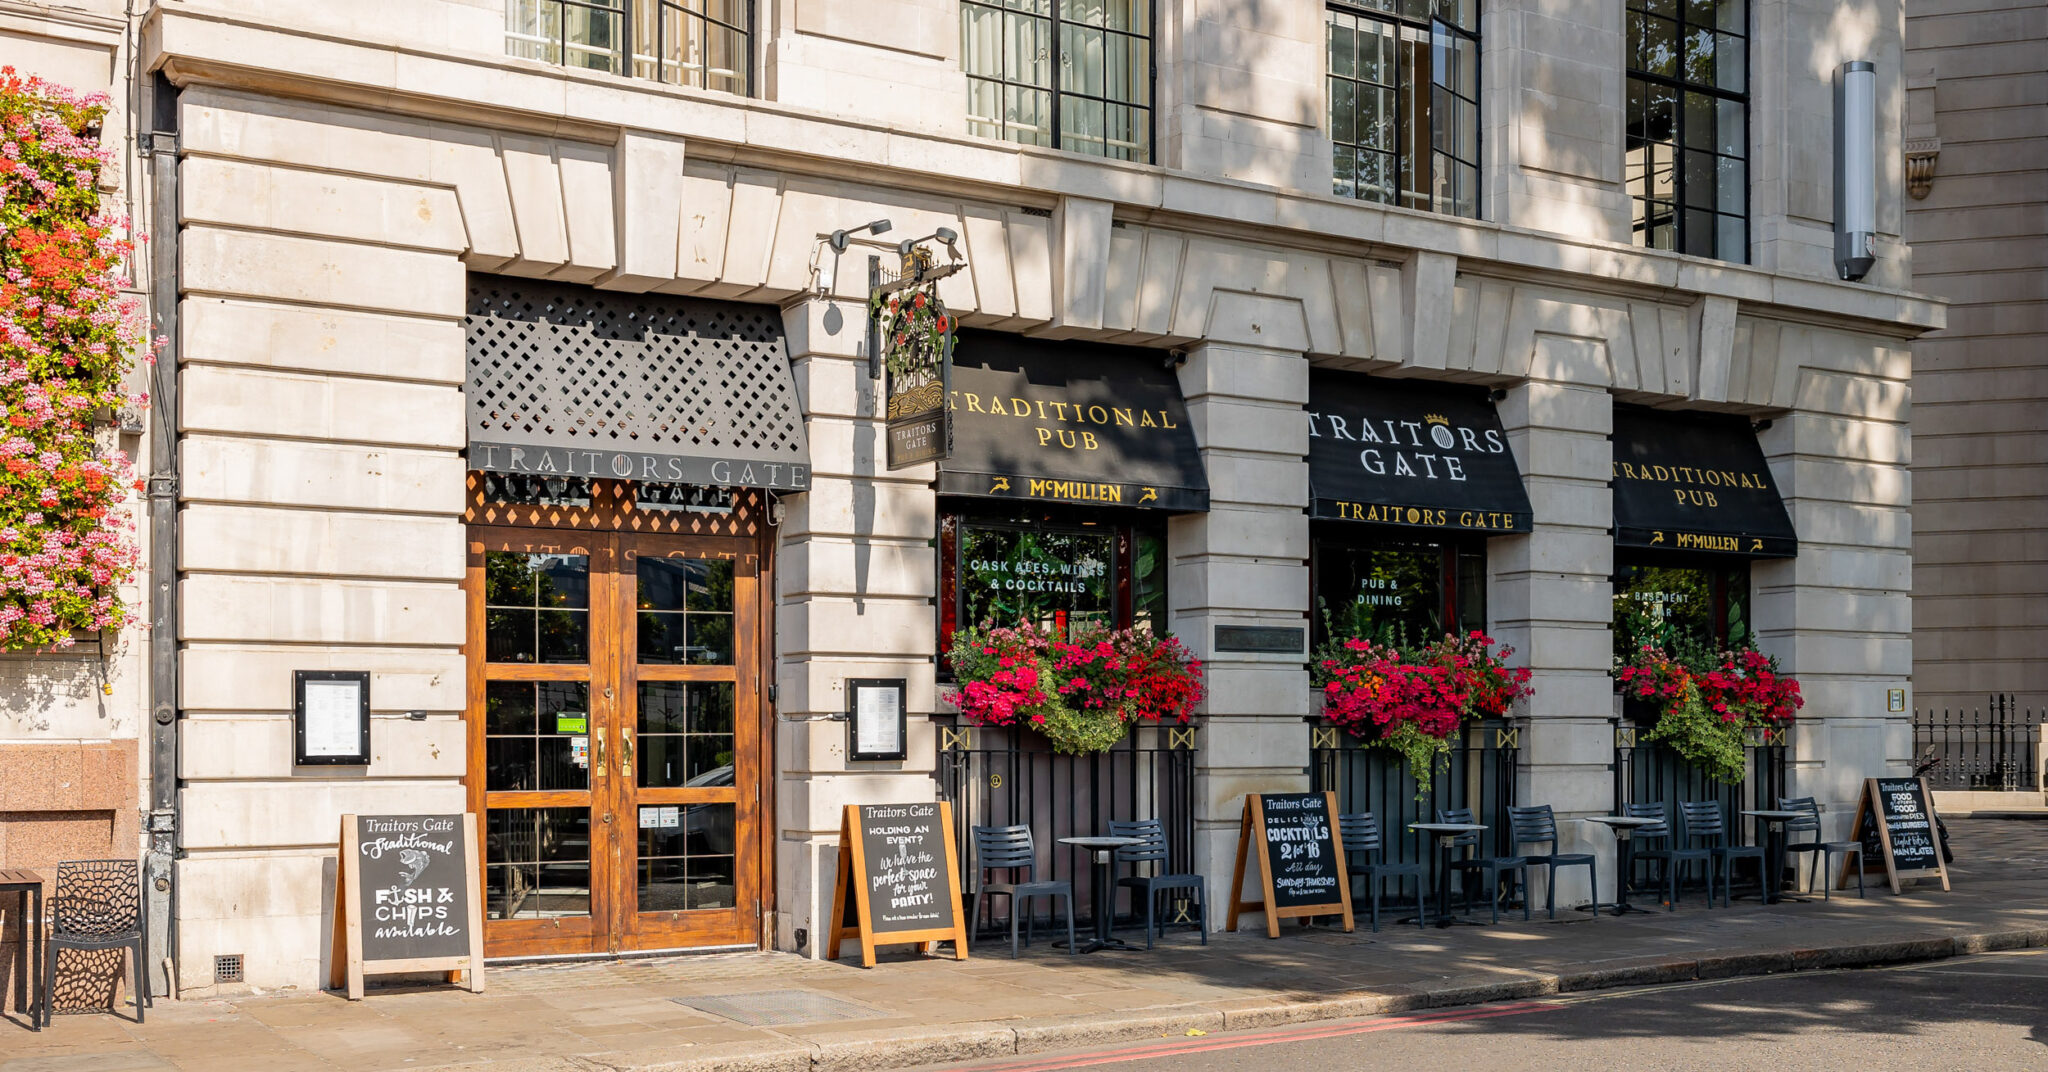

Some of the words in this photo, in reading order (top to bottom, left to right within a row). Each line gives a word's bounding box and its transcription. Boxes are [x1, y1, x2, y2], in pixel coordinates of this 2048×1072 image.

[950, 391, 1177, 429] TRADITIONAL
[896, 422, 937, 441] TRAITORS
[1035, 427, 1099, 450] PUB
[1308, 412, 1504, 453] TRAITORS
[905, 436, 928, 450] GATE
[478, 445, 683, 480] TRAITORS
[711, 460, 806, 488] GATE
[1360, 449, 1467, 481] GATE
[1612, 461, 1767, 489] TRADITIONAL
[1674, 489, 1718, 507] PUB
[1336, 501, 1446, 526] TRAITORS
[1460, 511, 1513, 529] GATE
[970, 559, 1009, 572] CASK
[990, 578, 1000, 590] &
[1005, 579, 1086, 593] COCKTAILS
[1361, 578, 1386, 590] PUB
[1390, 579, 1398, 590] &
[1357, 594, 1402, 606] DINING
[1634, 591, 1689, 603] BASEMENT
[1880, 782, 1904, 792] Traitors
[1266, 799, 1300, 810] Traitors
[1301, 798, 1322, 809] Gate
[1891, 793, 1913, 801] FOOD
[865, 806, 907, 819] Traitors
[909, 804, 934, 817] Gate
[1894, 805, 1918, 813] FOOD!
[1909, 812, 1925, 820] PIES
[366, 819, 419, 833] Traitors
[422, 818, 454, 832] Gate
[869, 826, 911, 835] HOLDING
[914, 825, 930, 834] AN
[361, 833, 453, 859] Traditional
[886, 835, 924, 845] EVENT?
[1280, 842, 1293, 860] 2
[1292, 844, 1304, 858] for
[1893, 848, 1910, 857] MAIN
[1910, 847, 1934, 856] PLATES
[880, 856, 894, 871] We
[917, 851, 934, 864] the
[1285, 862, 1304, 873] All
[1305, 861, 1323, 875] day
[873, 867, 906, 892] perfect
[908, 867, 938, 886] space
[437, 887, 454, 904] &
[892, 884, 907, 897] for
[890, 892, 935, 909] PARTY!
[375, 922, 461, 938] available
